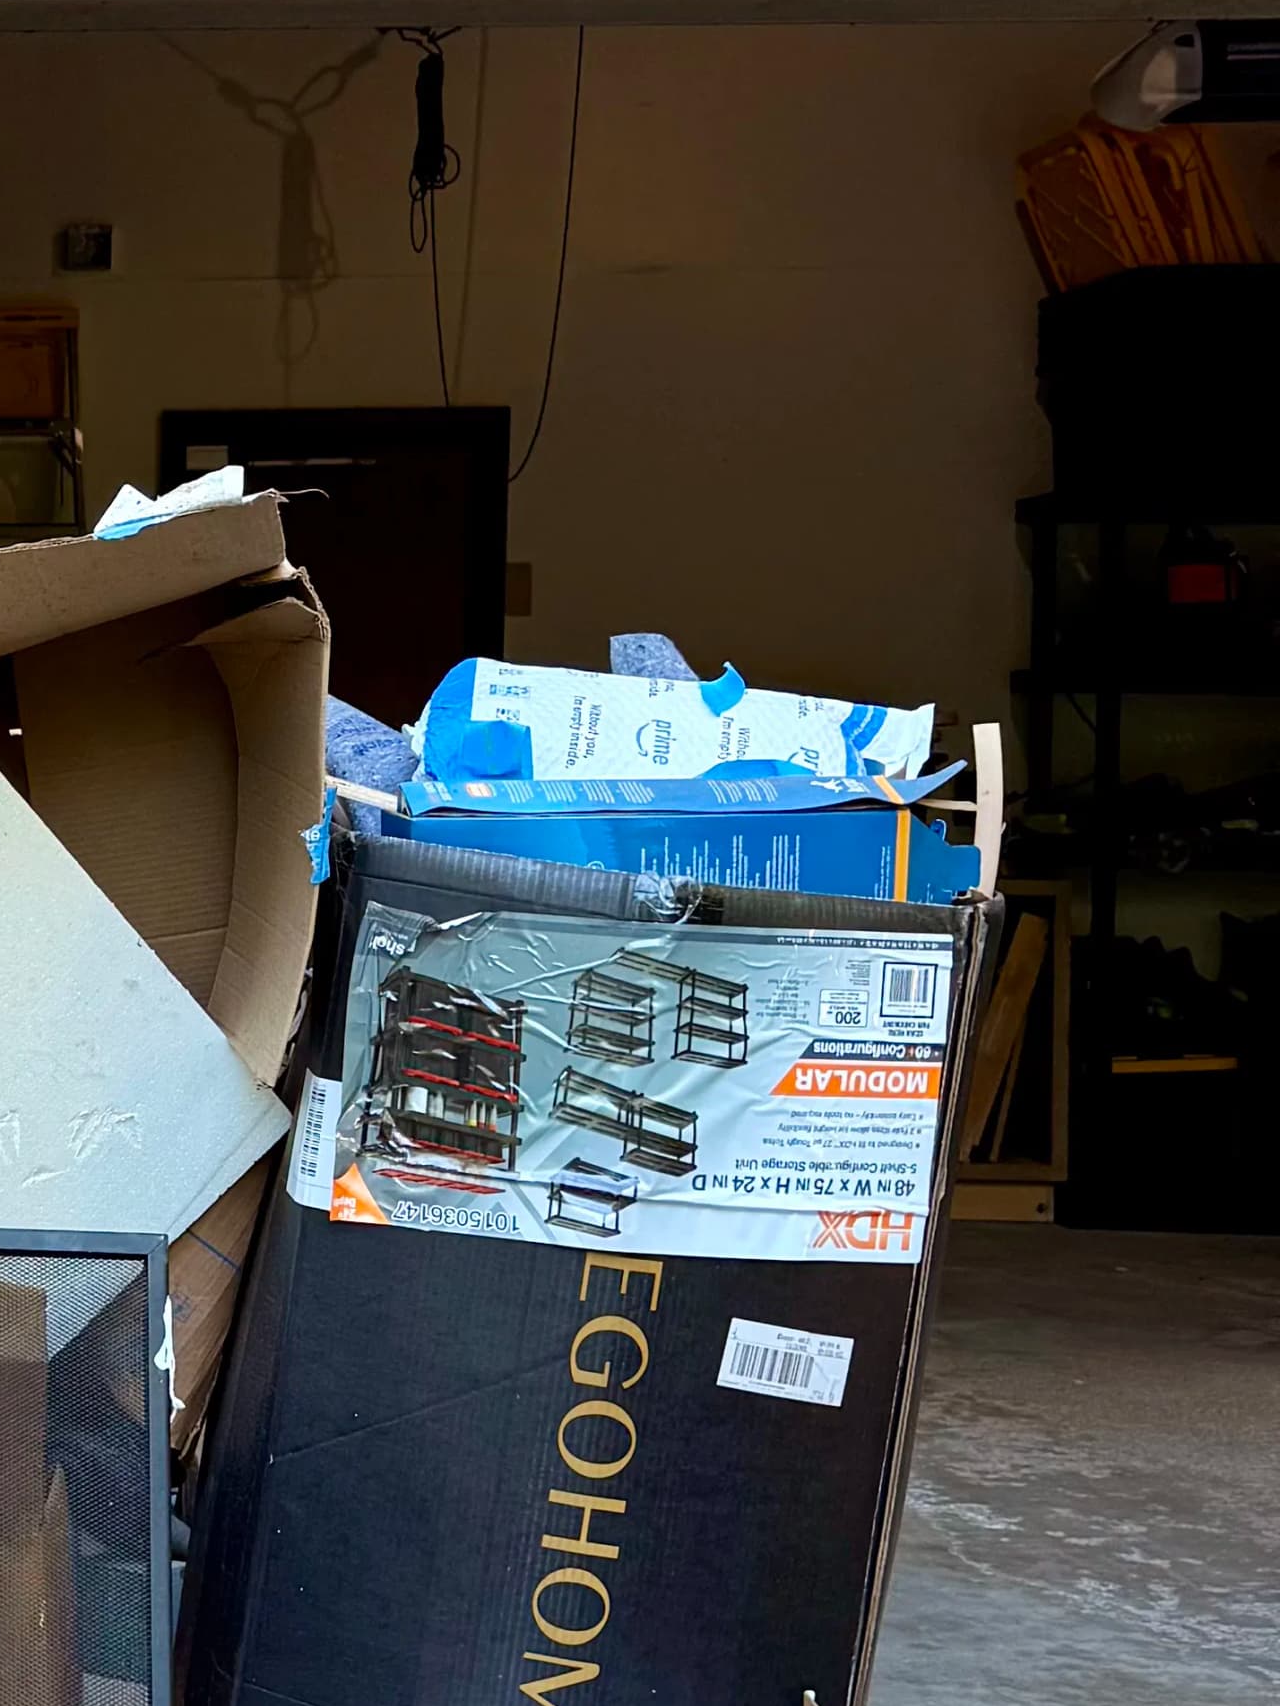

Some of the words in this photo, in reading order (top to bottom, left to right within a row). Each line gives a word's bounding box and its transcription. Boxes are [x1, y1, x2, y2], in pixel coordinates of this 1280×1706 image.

[652, 719, 674, 767] prime
[835, 1011, 862, 1025] 200
[813, 1041, 907, 1059] Configurations
[795, 1068, 929, 1093] MODULAR
[735, 1158, 759, 1171] Unit
[761, 1158, 807, 1173] Storage
[880, 1163, 918, 1175] 5-Shelf
[692, 1174, 707, 1191] D
[713, 1175, 728, 1189] IN
[732, 1176, 756, 1193] 24
[775, 1177, 791, 1194] H
[795, 1177, 810, 1192] IN
[813, 1178, 835, 1195] 75
[852, 1179, 872, 1196] W
[877, 1179, 892, 1193] IN
[895, 1180, 916, 1197] 48
[393, 1202, 521, 1235] 1015036147
[811, 1210, 915, 1252] HDX
